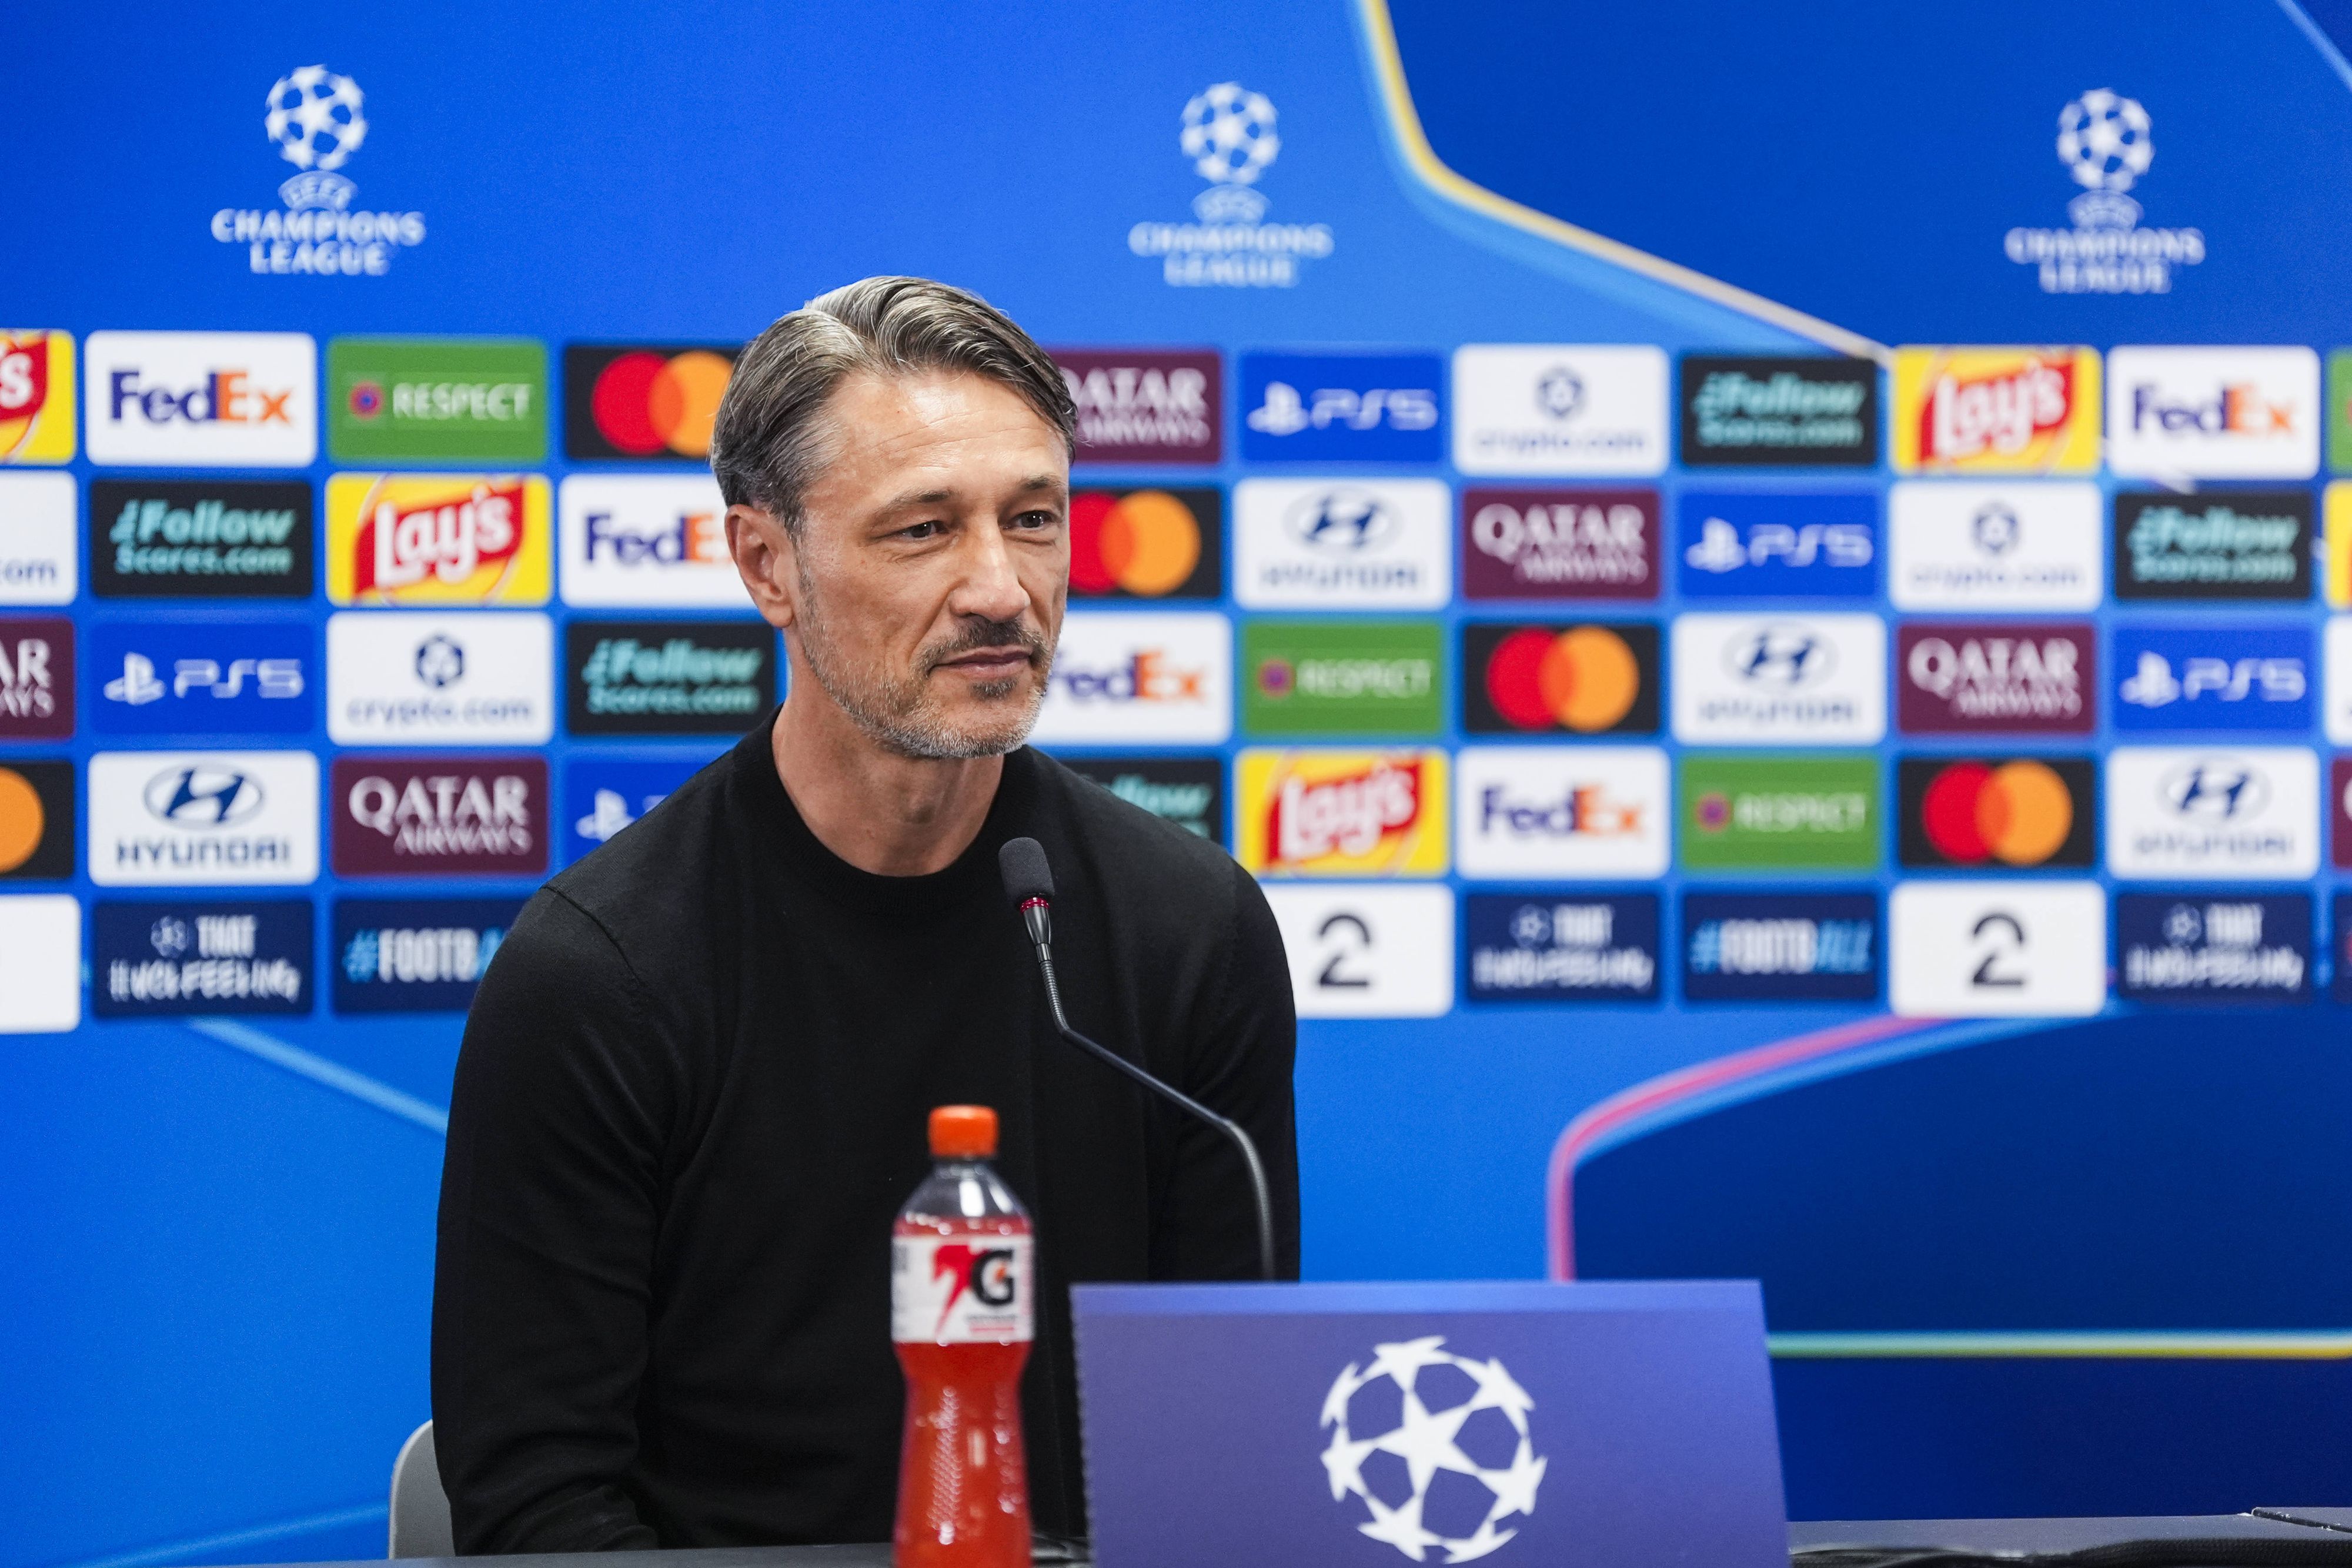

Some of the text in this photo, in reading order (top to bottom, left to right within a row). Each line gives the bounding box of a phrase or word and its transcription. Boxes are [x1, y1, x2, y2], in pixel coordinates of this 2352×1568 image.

[211, 209, 426, 246] CHAMPIONS
[250, 240, 389, 275] LEAGUE
[110, 370, 292, 423] FedEx
[392, 383, 532, 420] RESPECT
[1309, 389, 1438, 430] PS5
[1933, 357, 2067, 457] Lay's
[2133, 383, 2292, 435] FedEx
[137, 499, 295, 544] Follow
[374, 489, 514, 589] Lay's
[583, 513, 728, 567] FedE
[1472, 503, 1645, 563] QATAR
[1748, 524, 1873, 567] PS5
[173, 659, 304, 698] PS5
[1909, 638, 2078, 700] QATAR
[2184, 658, 2306, 701] PS5
[349, 775, 529, 836] QATAR
[1279, 764, 1414, 863] Lay's
[1481, 785, 1643, 836] FedEx
[116, 837, 292, 867] HYUNDAI
[393, 822, 533, 855] AIRWAYS
[1316, 912, 1372, 989] 2
[1970, 911, 2026, 988] 2
[971, 1249, 1014, 1307] G
